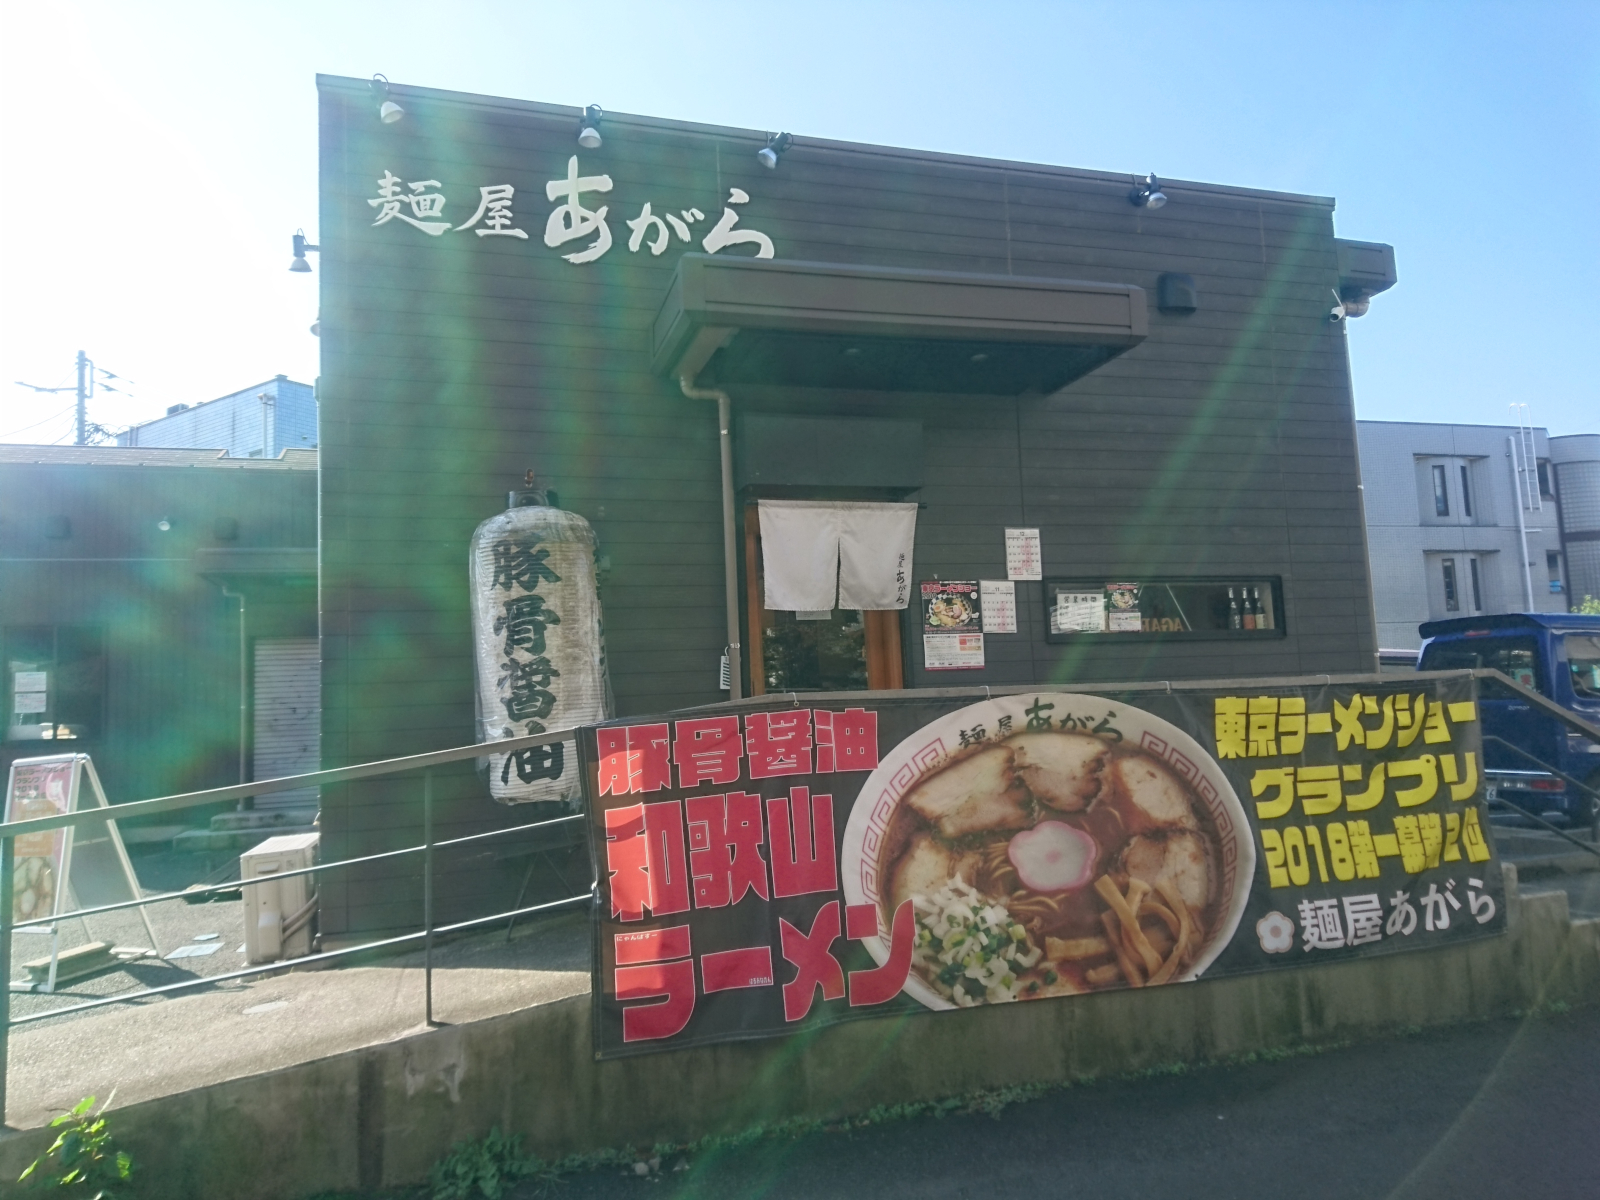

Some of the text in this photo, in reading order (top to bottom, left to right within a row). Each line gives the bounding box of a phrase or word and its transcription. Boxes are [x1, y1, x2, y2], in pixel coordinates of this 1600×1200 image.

[596, 708, 878, 797] 豚骨醤油
[1214, 692, 1477, 760] 東京ラーメンショー
[1250, 752, 1478, 820] グランプリ
[604, 786, 838, 923] 和歌山
[1297, 877, 1496, 952] 麺屋あがら
[615, 899, 916, 1043] ラーメン
